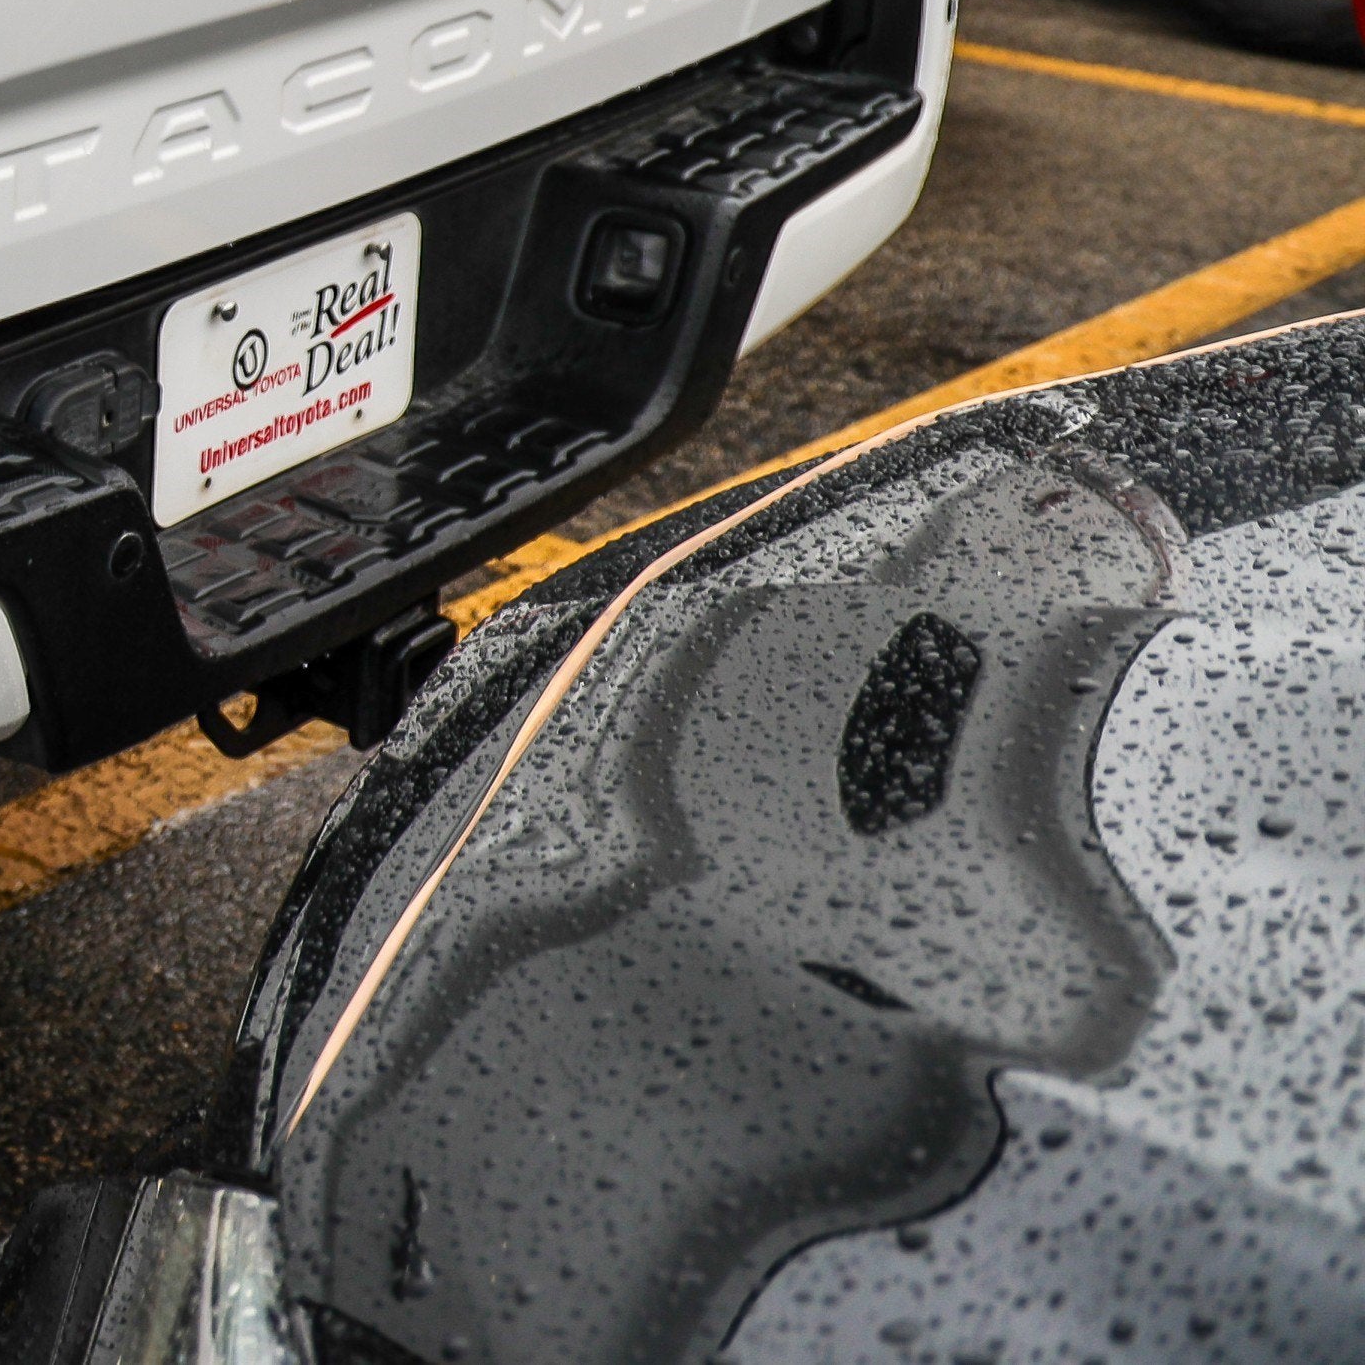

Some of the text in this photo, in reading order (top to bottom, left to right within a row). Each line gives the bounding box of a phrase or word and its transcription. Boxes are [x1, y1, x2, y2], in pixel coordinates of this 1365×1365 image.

[310, 240, 392, 339] Real
[303, 302, 401, 397] Deal!
[174, 362, 302, 433] UNIVERSAL TOYOTA
[200, 381, 372, 474] Universaltoyota.com
